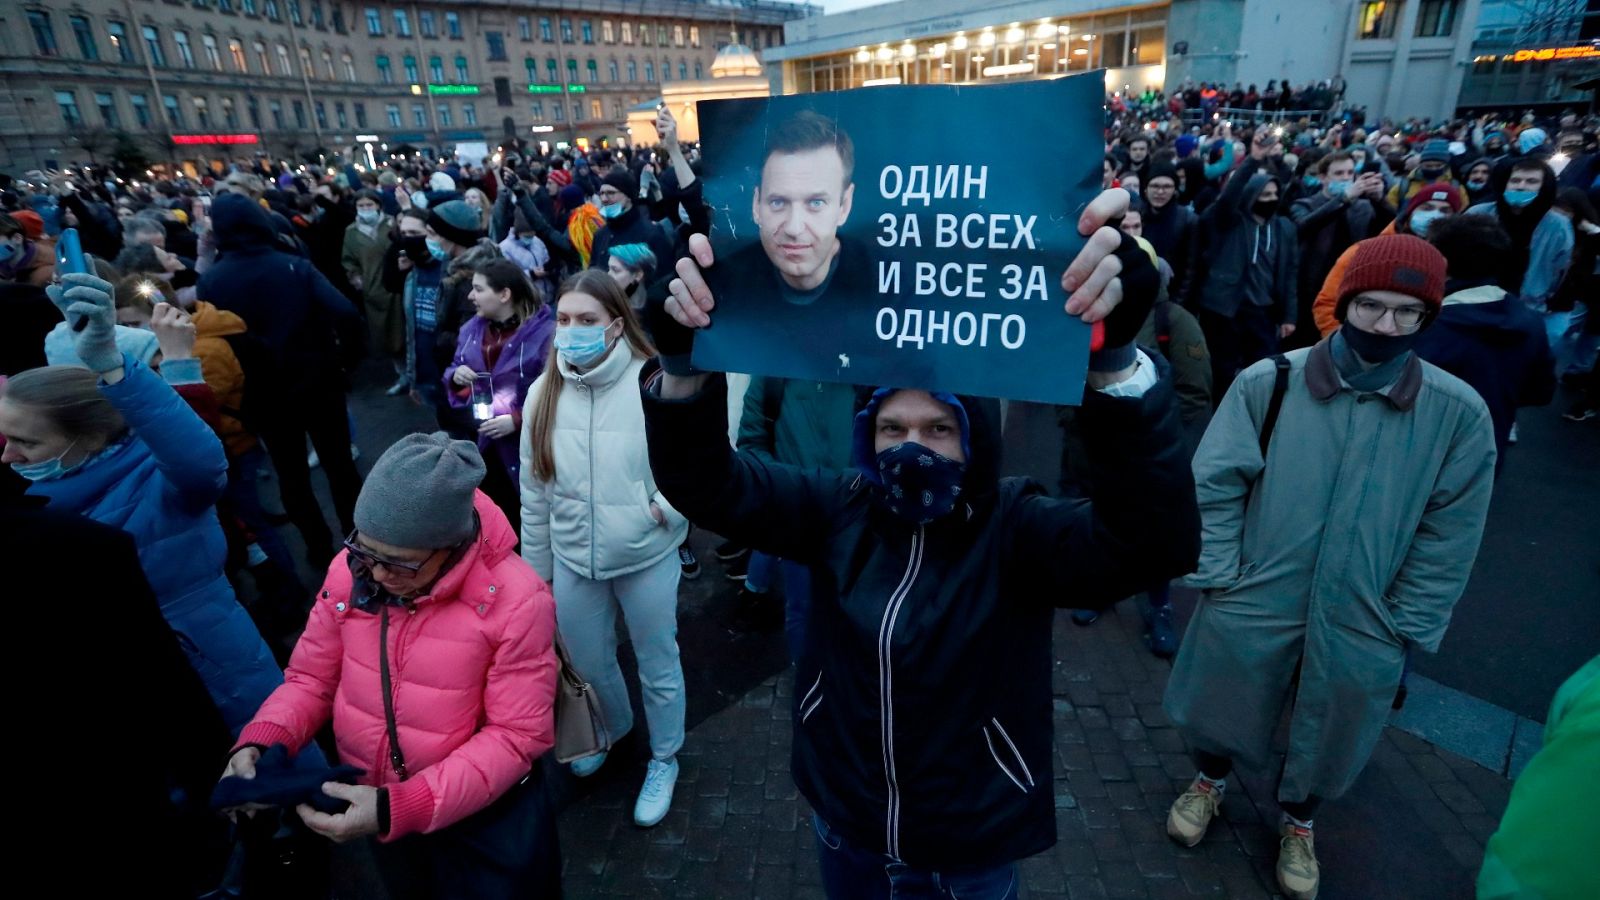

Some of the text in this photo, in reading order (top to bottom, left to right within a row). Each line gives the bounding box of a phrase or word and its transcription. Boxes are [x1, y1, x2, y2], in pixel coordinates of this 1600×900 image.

[1514, 48, 1555, 62] DNS
[879, 164, 988, 207] ОДИН
[876, 212, 1038, 250] ЗА ВСЕХ
[878, 261, 1049, 301] И ВСЕ ЗА
[875, 306, 1026, 350] ОДНОГО
